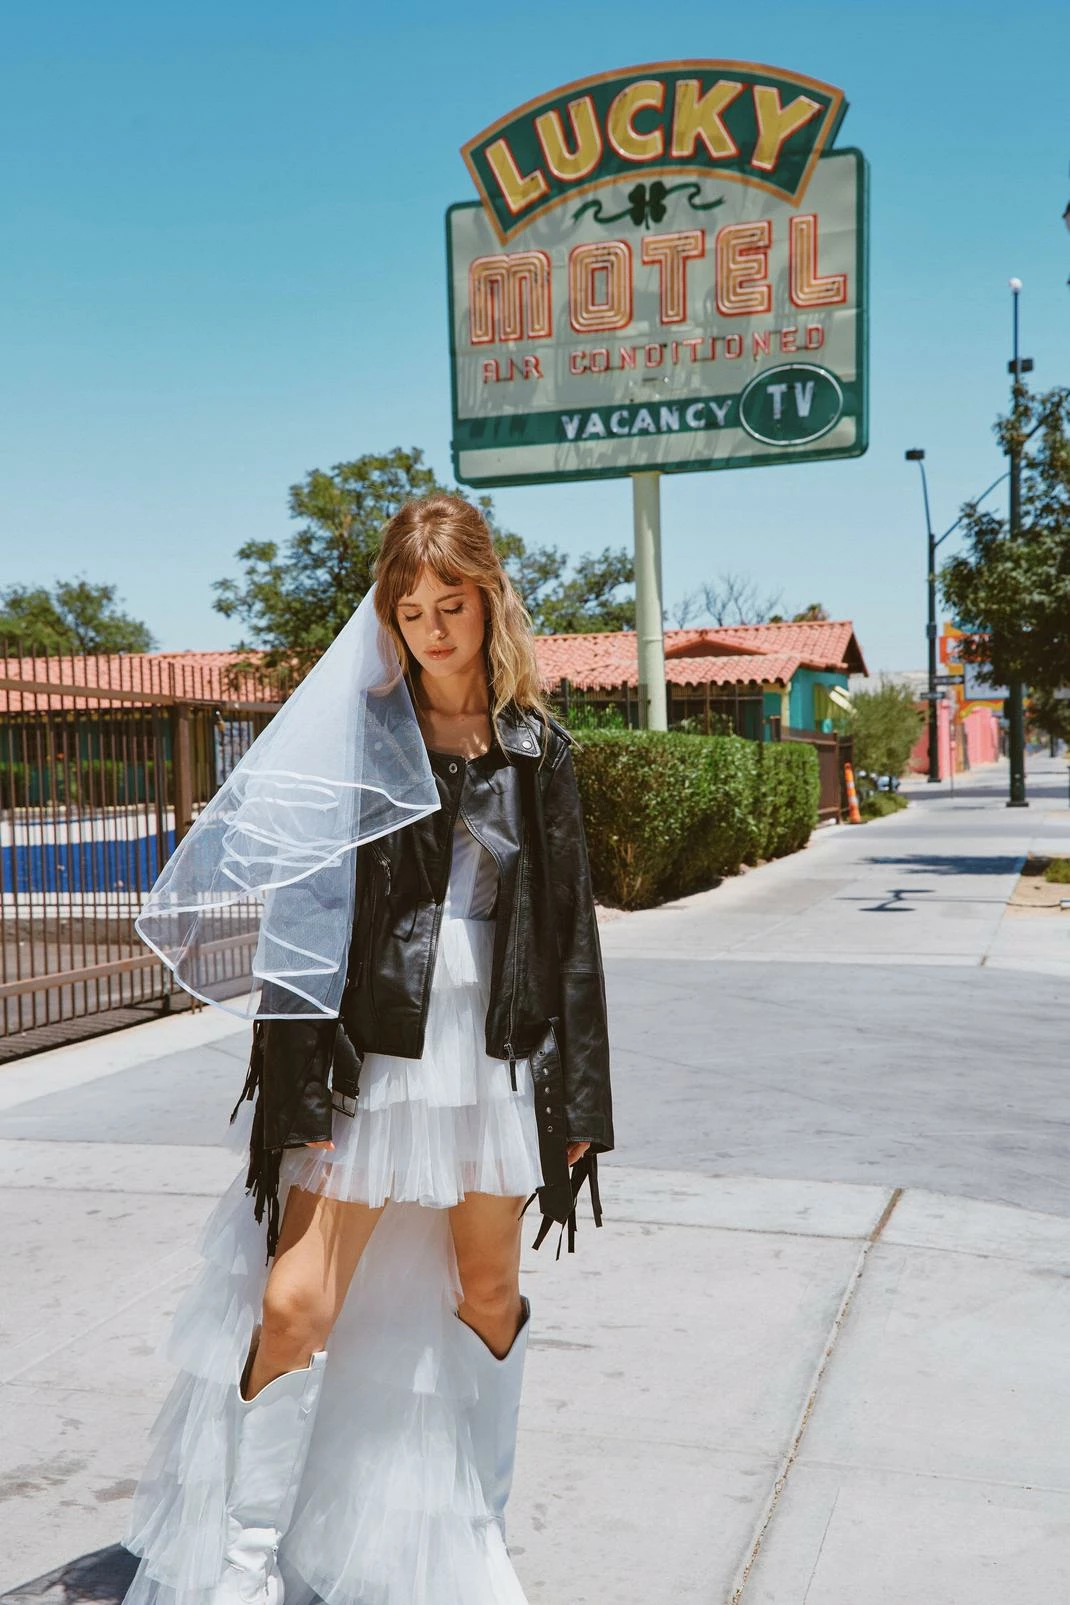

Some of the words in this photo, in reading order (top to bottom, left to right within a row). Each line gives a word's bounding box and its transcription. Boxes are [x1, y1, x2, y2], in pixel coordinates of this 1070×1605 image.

[485, 79, 824, 216] LUCKY
[469, 214, 847, 345] MOTEL
[483, 355, 543, 383] AIR
[569, 324, 824, 374] CONDITIONED
[561, 401, 731, 439] VACANCY
[766, 381, 816, 419] TV
